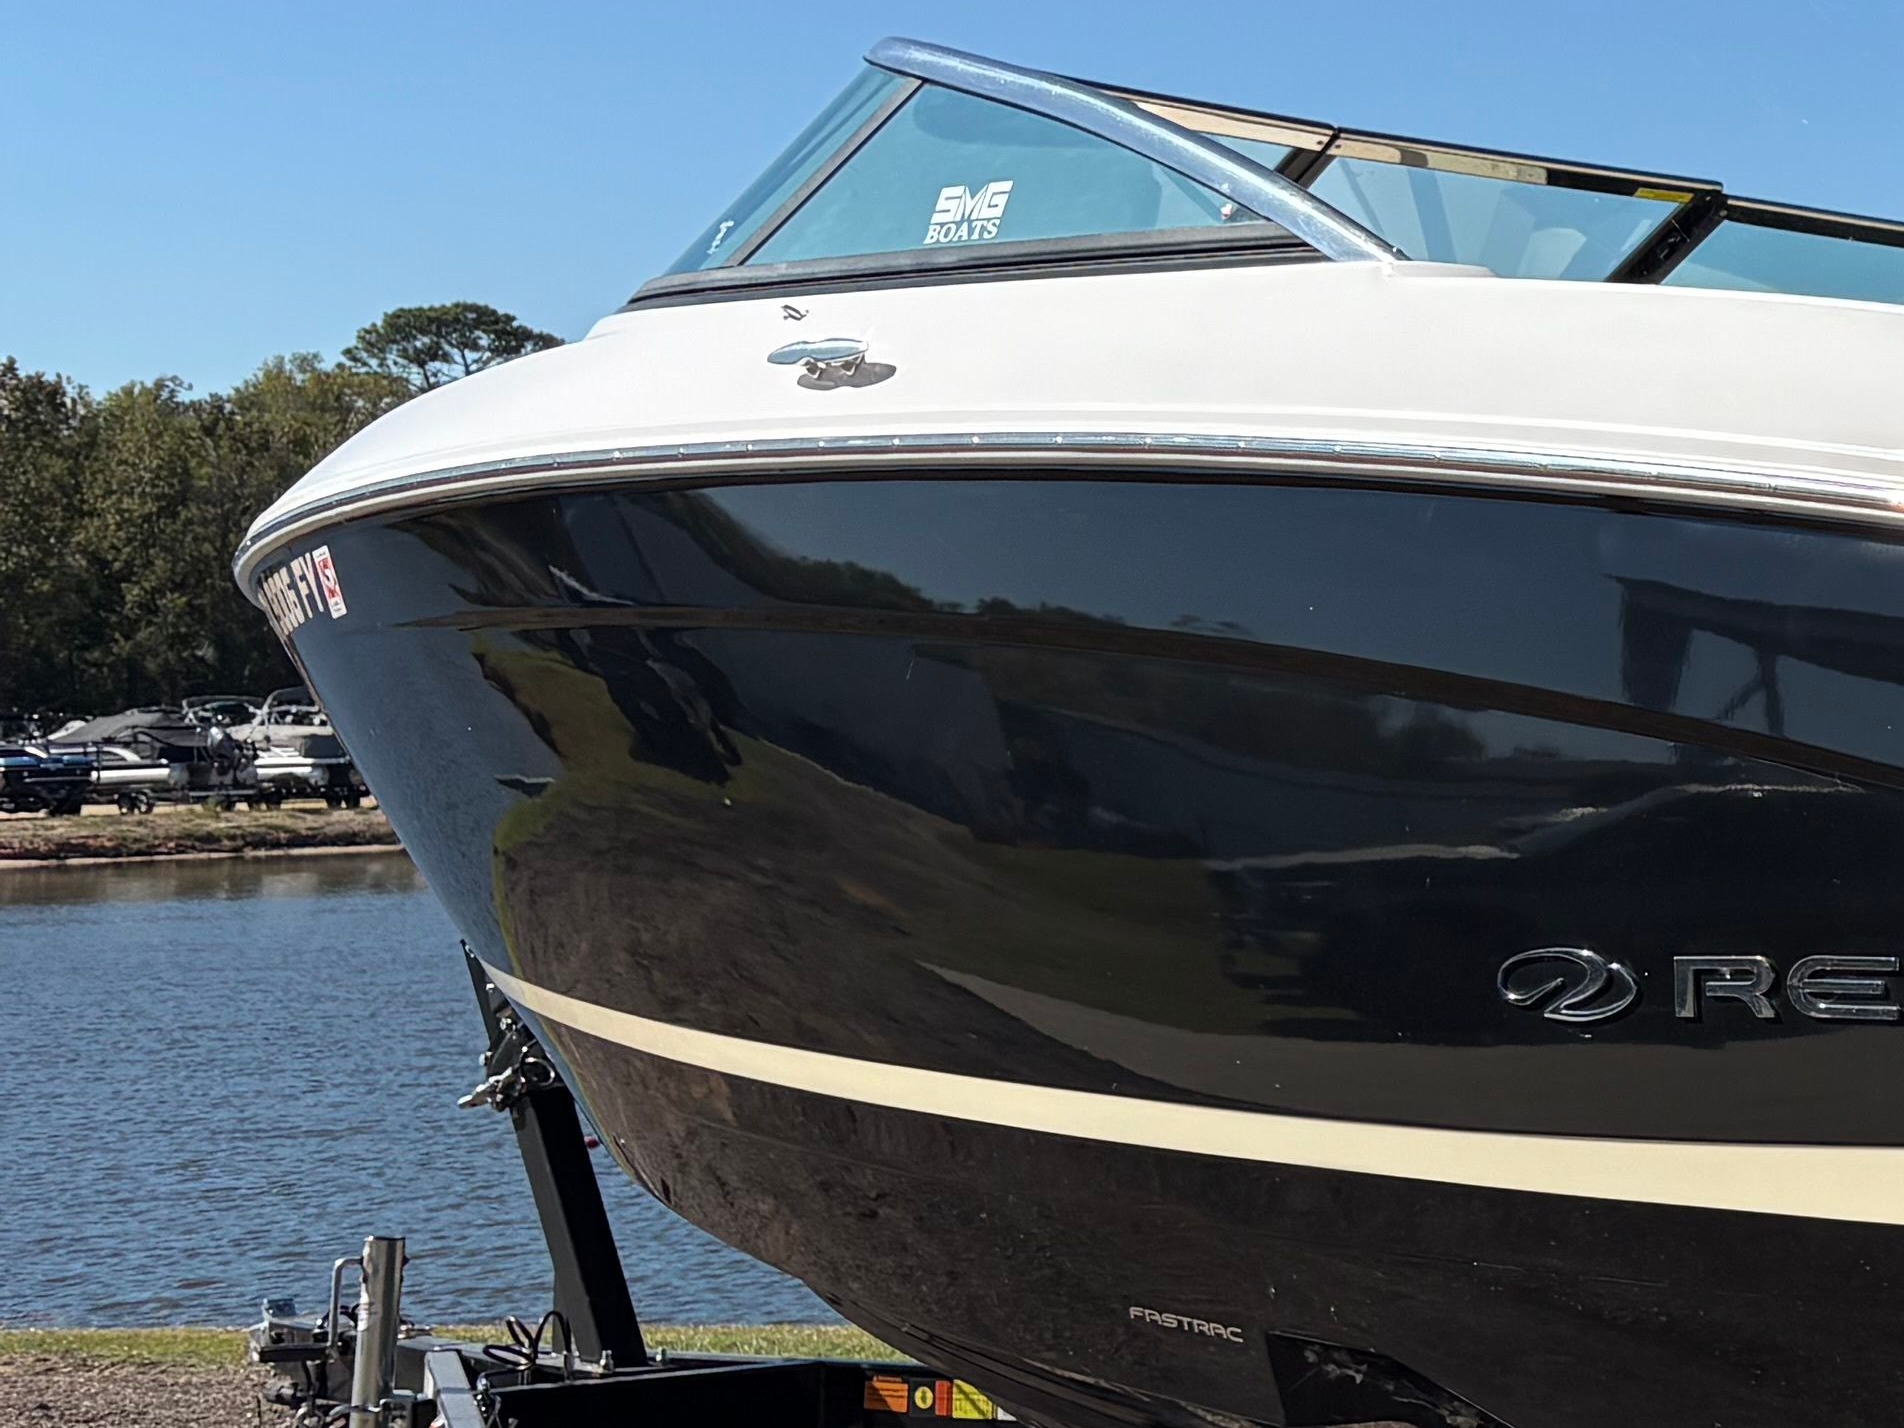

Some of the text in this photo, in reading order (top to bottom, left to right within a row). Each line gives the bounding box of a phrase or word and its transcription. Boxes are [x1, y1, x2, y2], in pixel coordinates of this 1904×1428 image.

[931, 180, 1013, 224] SMG
[923, 219, 1000, 244] BOATS
[1129, 1307, 1244, 1342] FASTRAC
